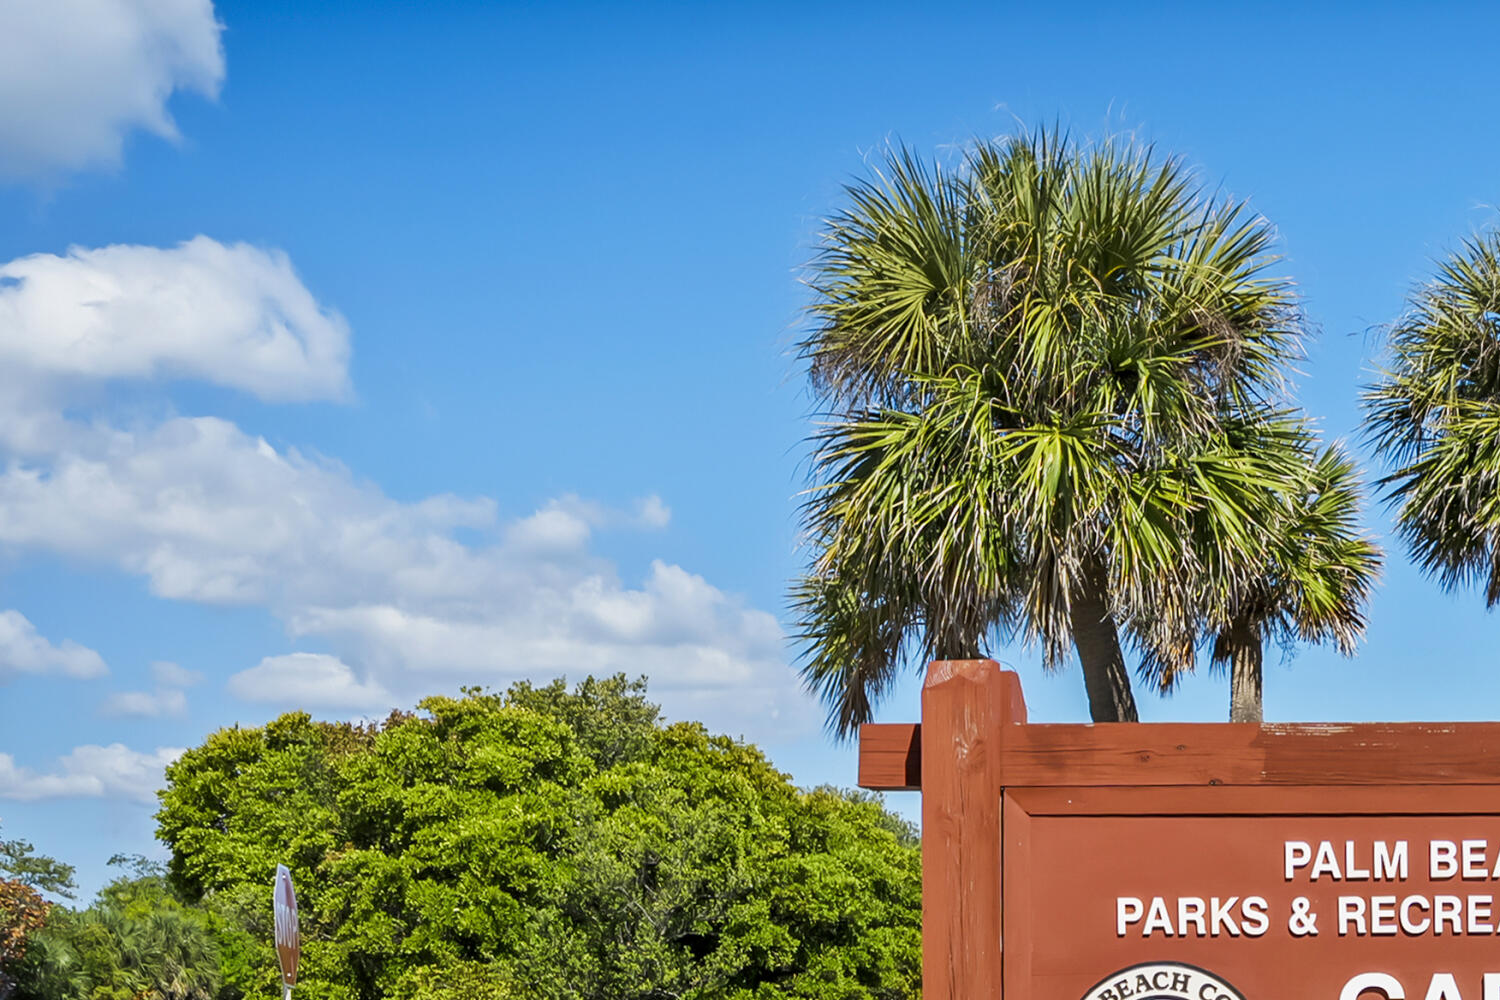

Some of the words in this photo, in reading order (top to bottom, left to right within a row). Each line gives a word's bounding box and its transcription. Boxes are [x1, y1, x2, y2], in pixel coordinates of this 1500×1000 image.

[1284, 840, 1409, 879] PALM
[277, 902, 298, 949] STOP
[1116, 895, 1270, 935] PARKS
[1288, 896, 1319, 935] &
